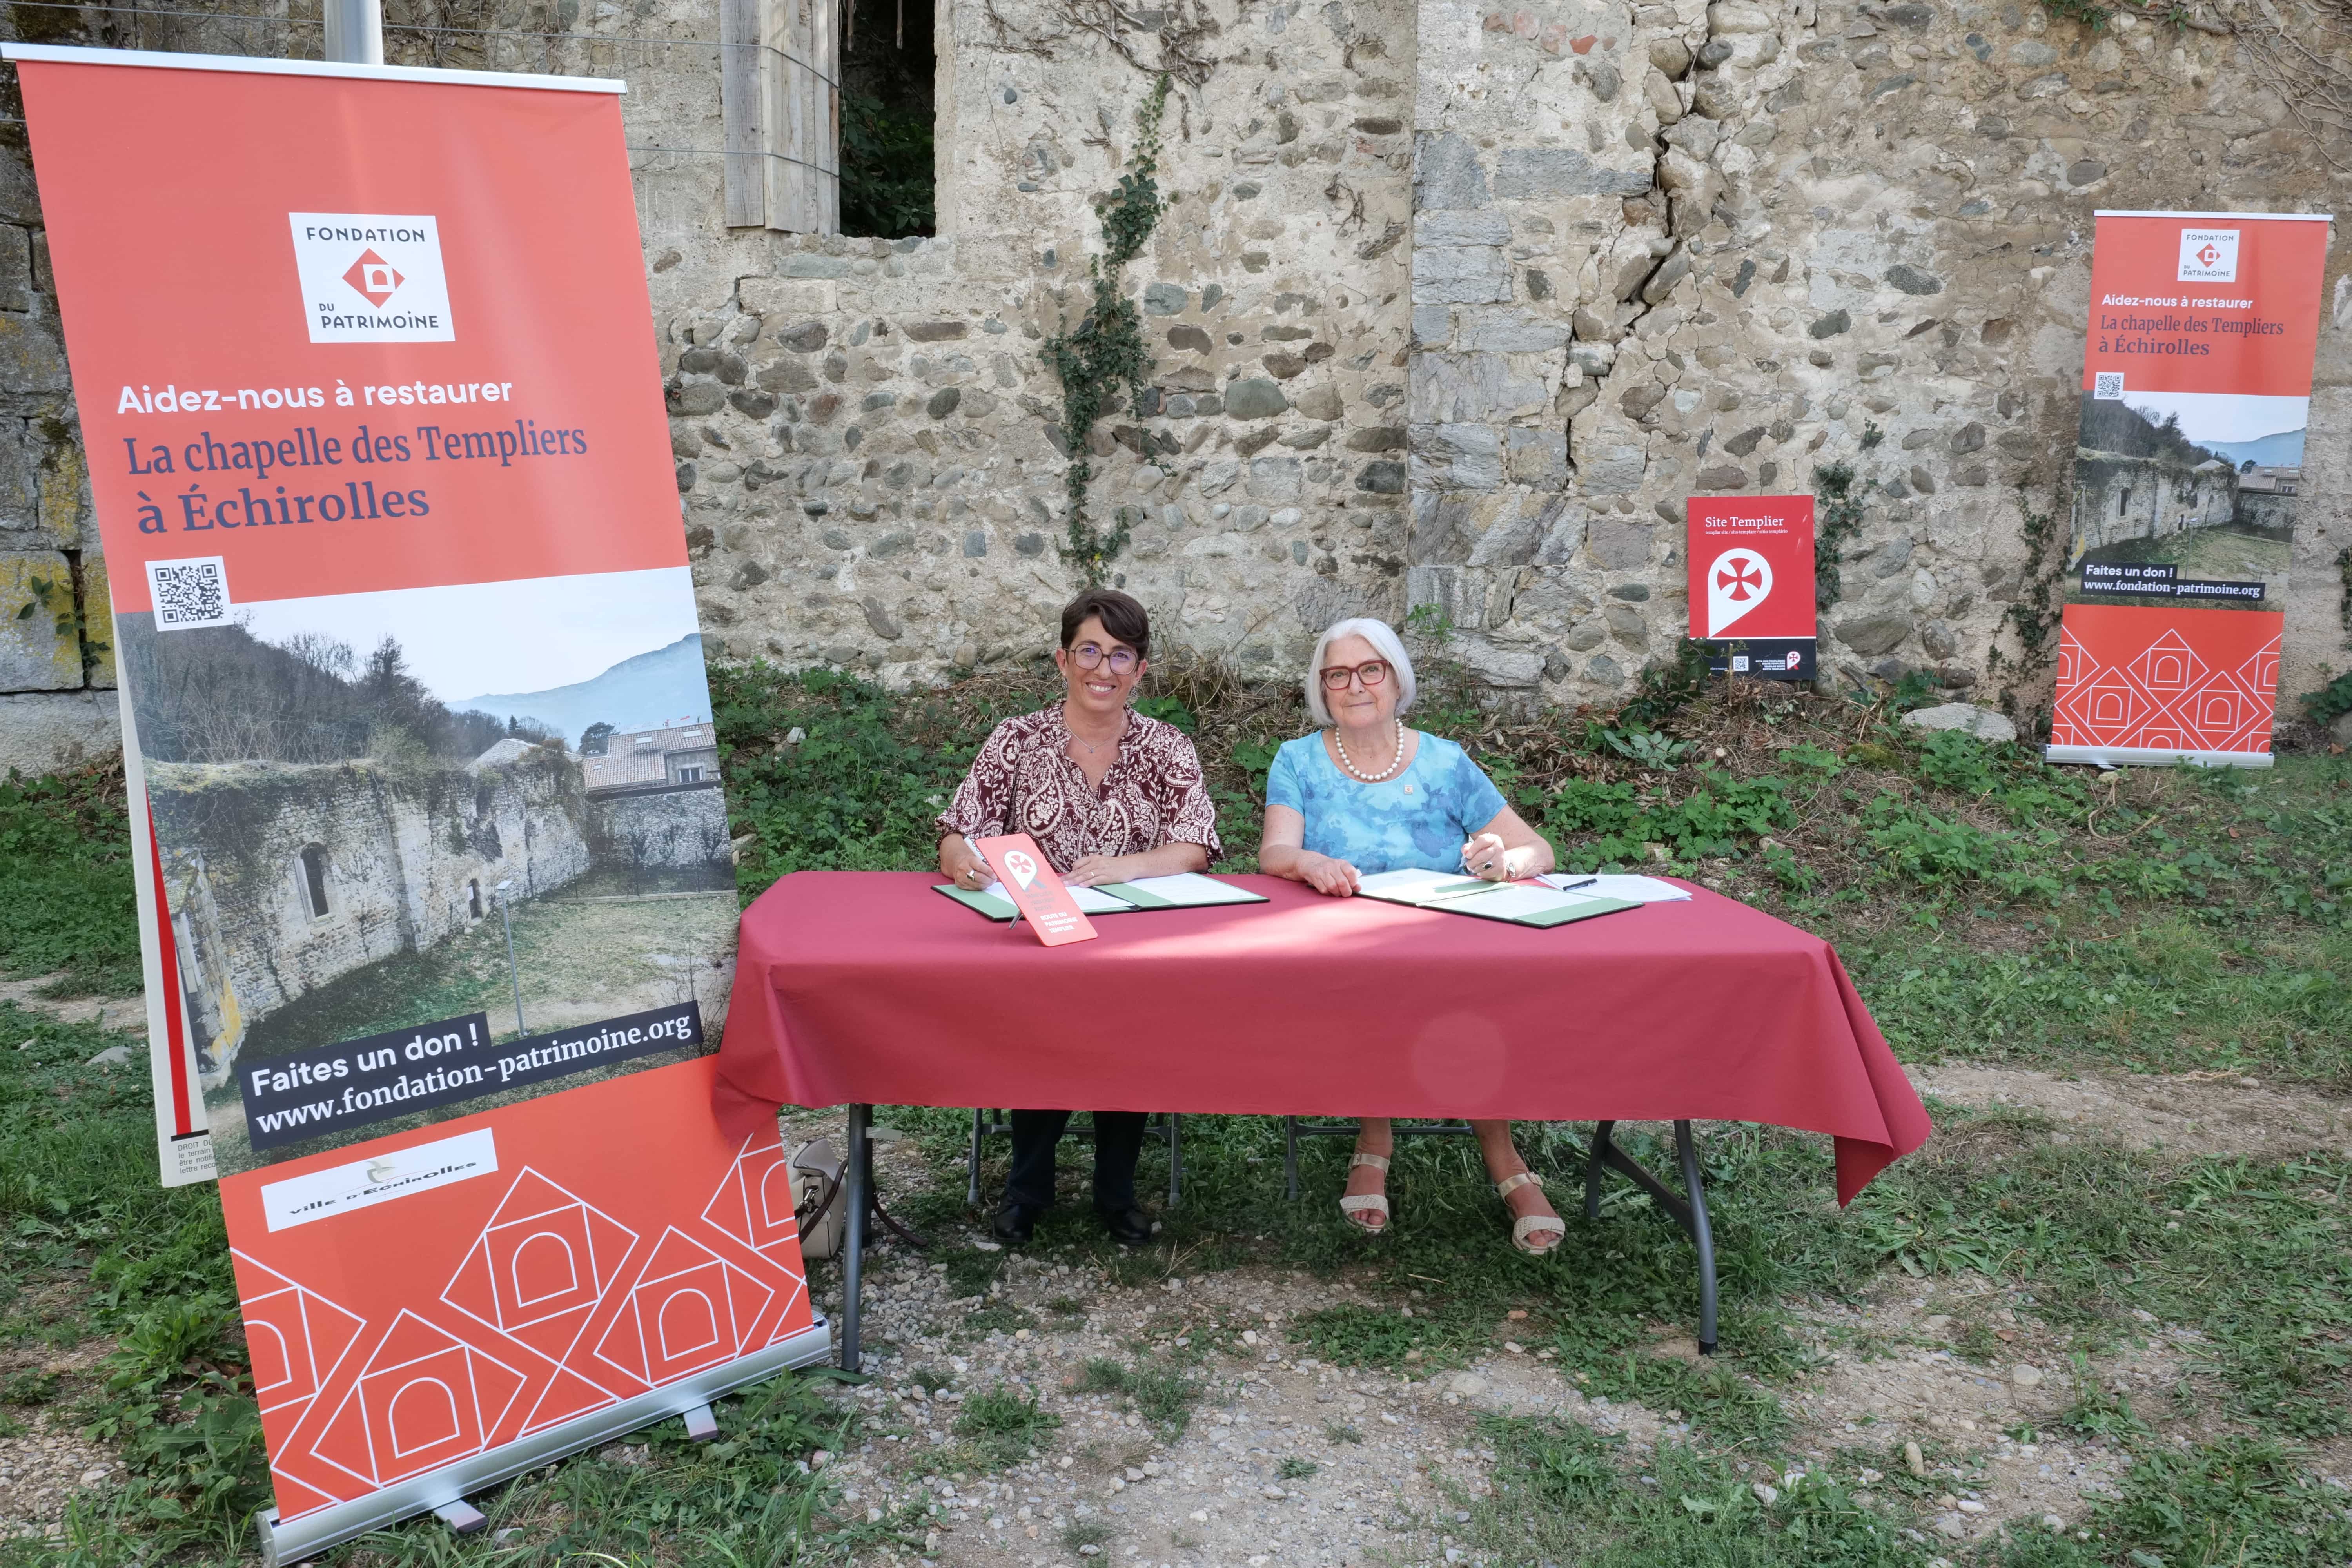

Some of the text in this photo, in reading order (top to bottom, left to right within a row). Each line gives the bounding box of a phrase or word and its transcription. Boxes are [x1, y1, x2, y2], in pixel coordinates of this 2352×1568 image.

[306, 227, 425, 242] FONDATION
[319, 303, 334, 312] DU
[2102, 294, 2253, 309] Aidez-nous à restaurer
[2100, 314, 2283, 338] La chapelle des Templiers
[2098, 334, 2210, 355] à Échirolles
[118, 379, 512, 414] Aidez-nous à restaurer
[123, 419, 588, 479] La chapelle des Templiers
[137, 480, 430, 534] à Échirolles
[1706, 516, 1784, 529] Site Templier
[2086, 565, 2173, 578] Faites un don !
[2084, 580, 2260, 598] www.fondation-patrimoine.org
[251, 1023, 479, 1096] Faites un don !
[256, 1016, 692, 1133] www.fondation-patrimoine.org
[178, 1142, 199, 1151] DROIT
[188, 1148, 211, 1157] terrain
